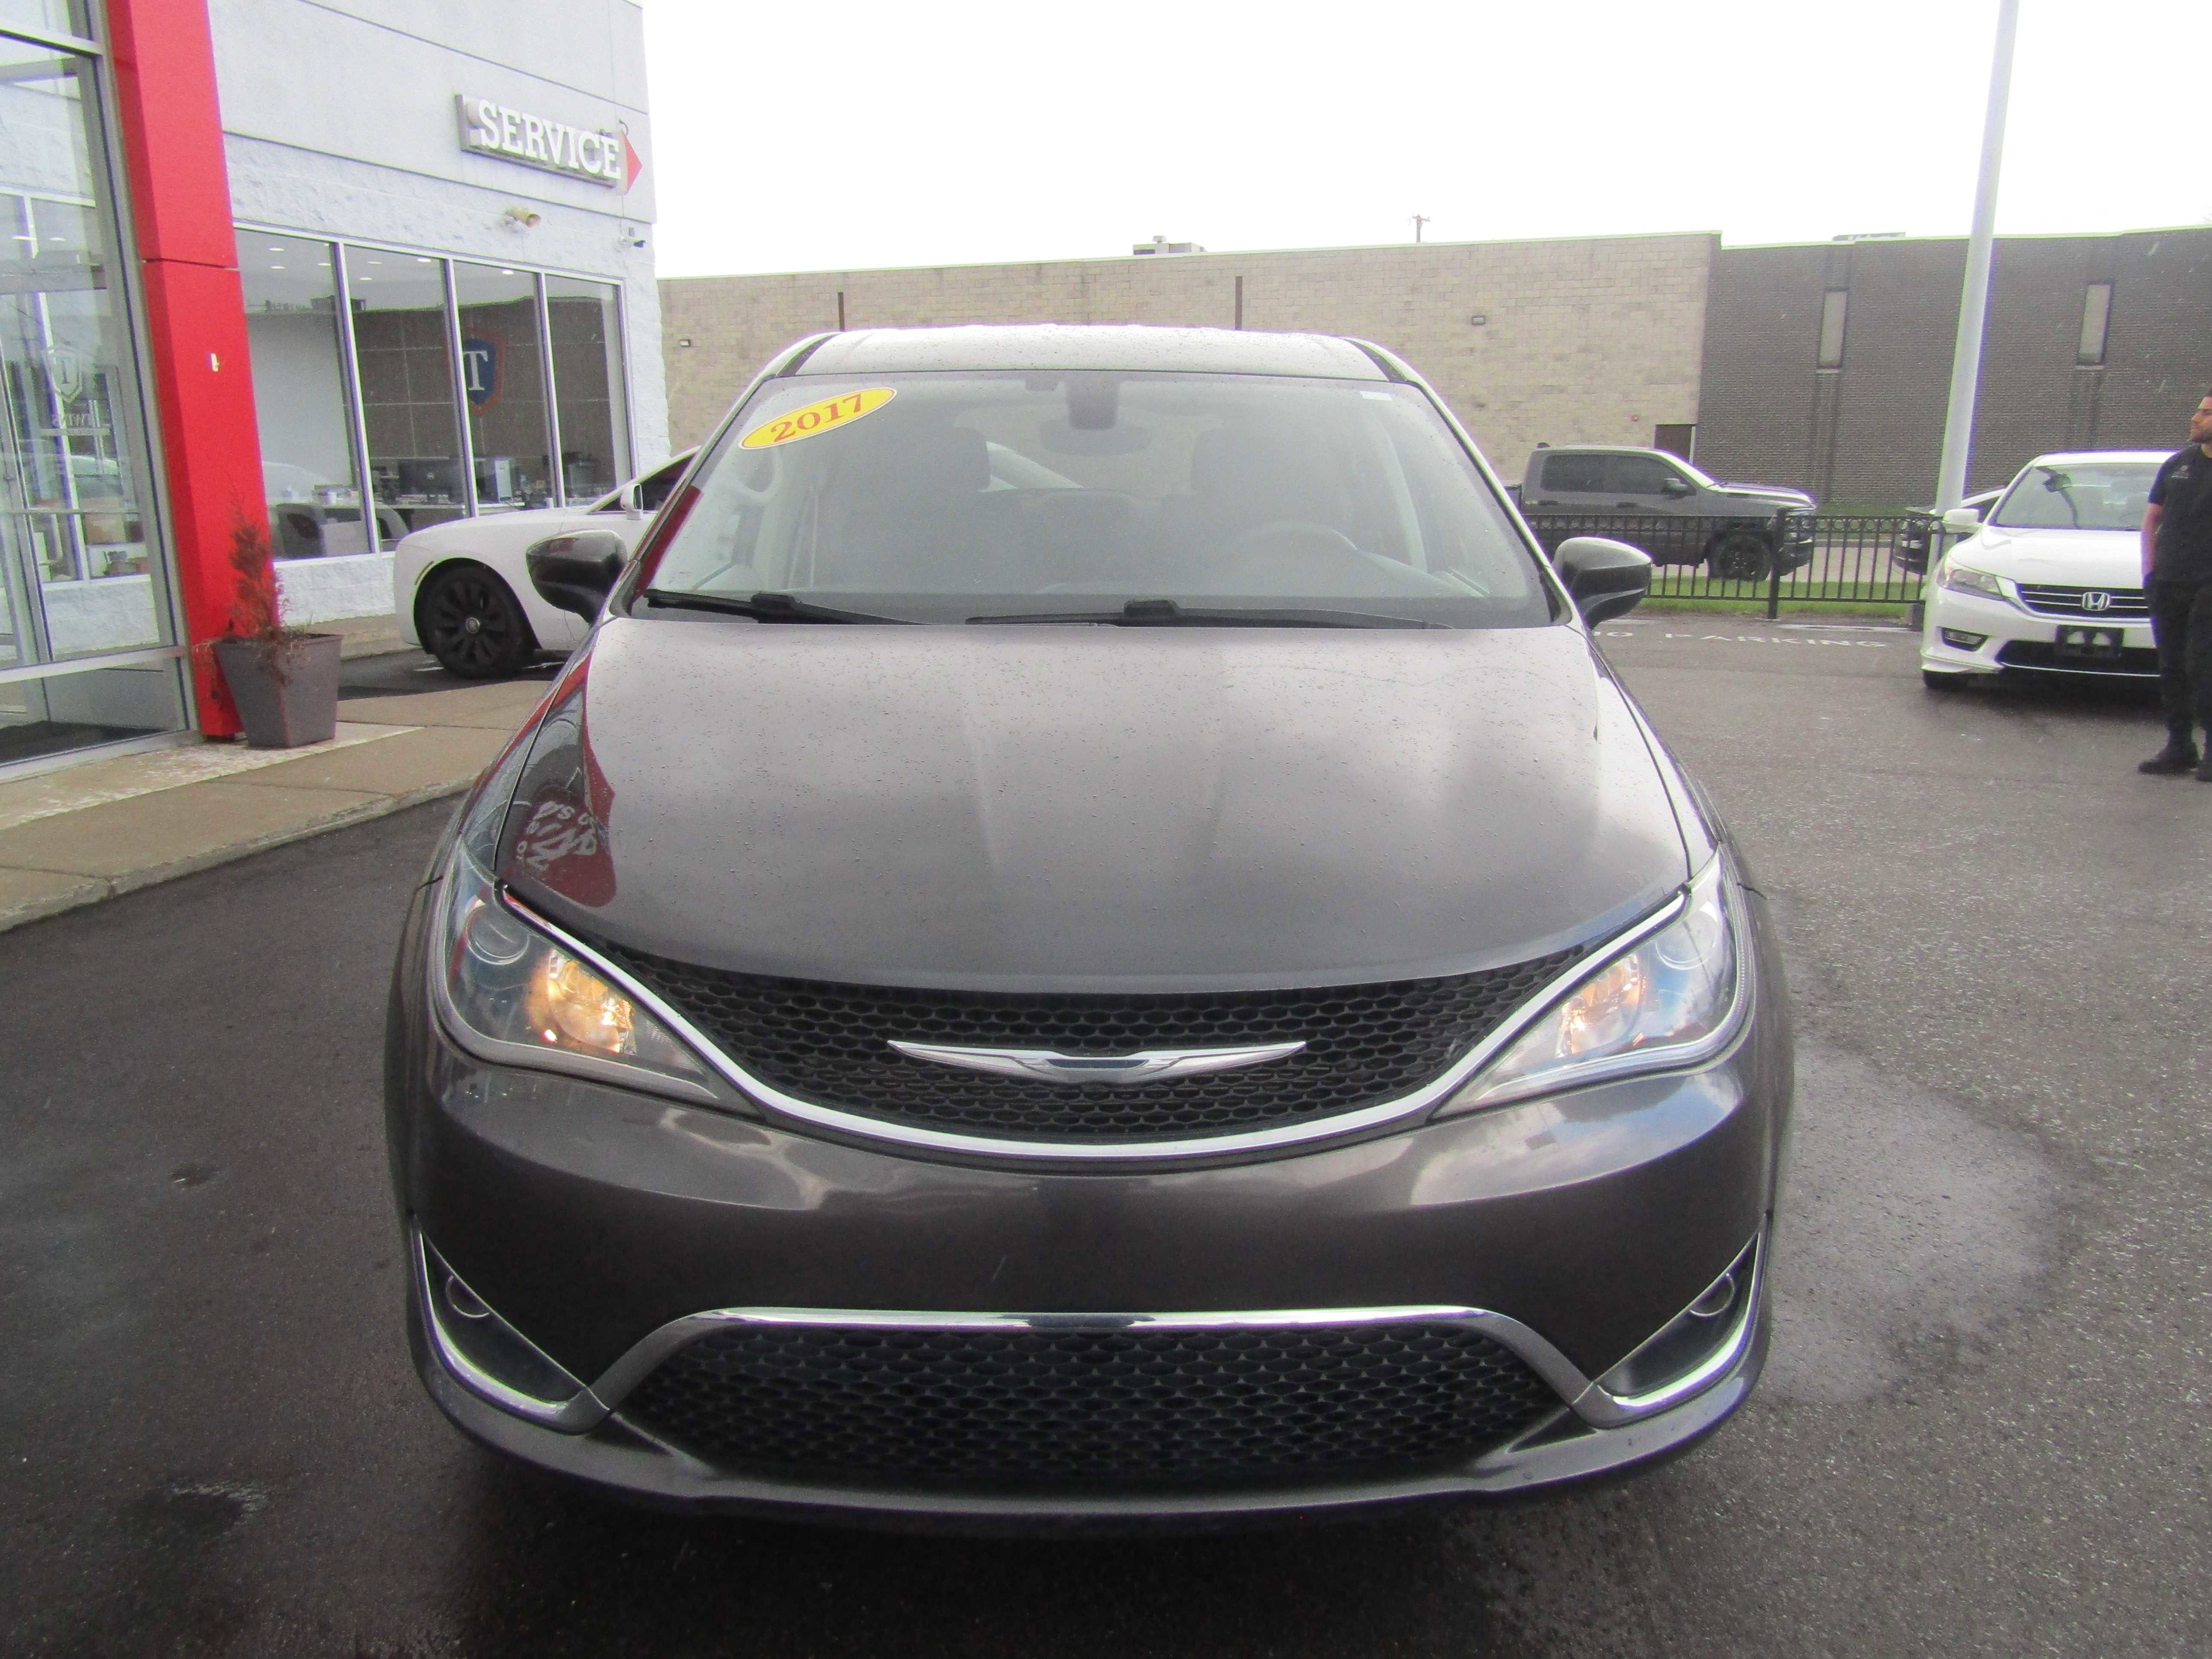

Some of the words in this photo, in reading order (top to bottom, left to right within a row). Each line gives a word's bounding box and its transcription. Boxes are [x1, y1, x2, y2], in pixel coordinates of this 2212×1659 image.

[479, 100, 621, 179] SERVICE
[463, 350, 489, 391] T
[771, 393, 863, 442] 2017
